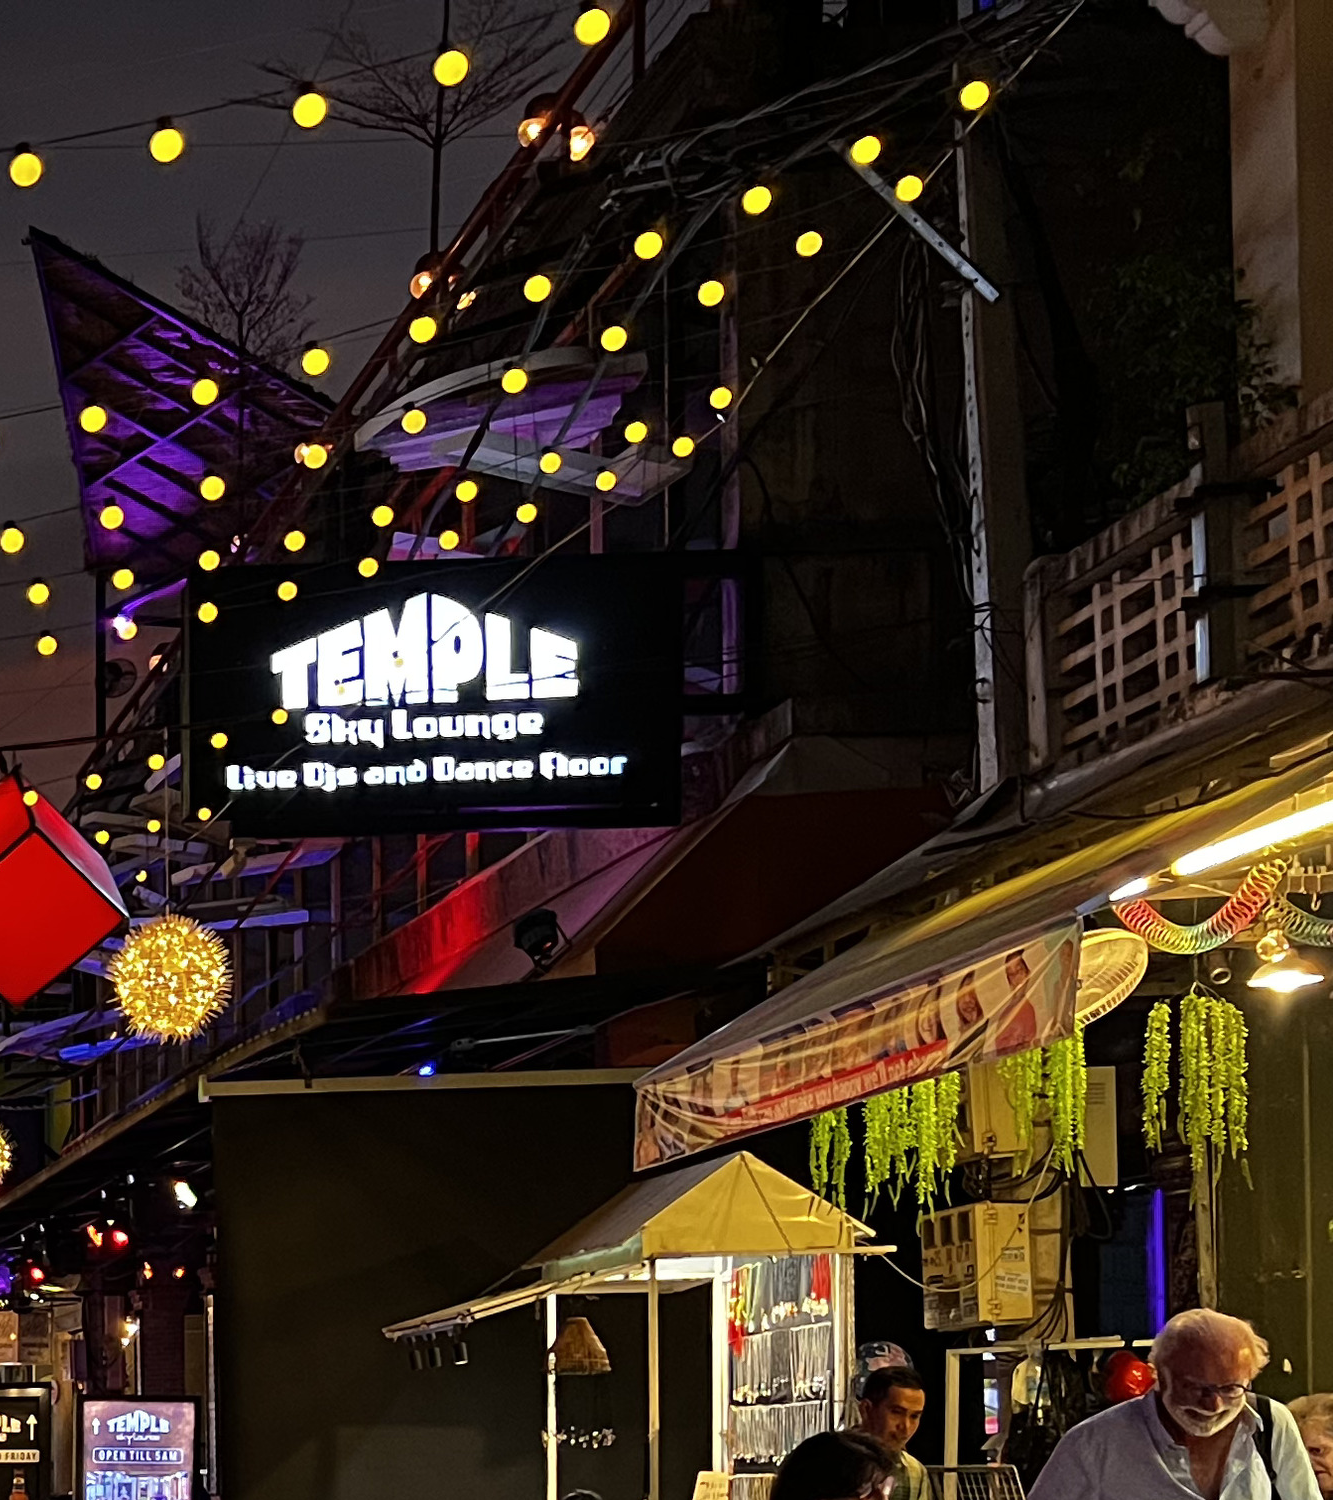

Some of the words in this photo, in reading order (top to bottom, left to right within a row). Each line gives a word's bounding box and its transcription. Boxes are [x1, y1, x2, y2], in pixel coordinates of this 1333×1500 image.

[270, 591, 580, 710] TEMPLE
[304, 711, 385, 749] Sky
[390, 708, 545, 741] Lounge
[225, 764, 298, 791] Live
[362, 758, 428, 786] and
[432, 755, 534, 783] Dance
[106, 1409, 170, 1433] TEMPLE
[5, 1452, 37, 1461] FRIDAY
[98, 1450, 127, 1461] OPEN
[129, 1450, 152, 1461] TILL
